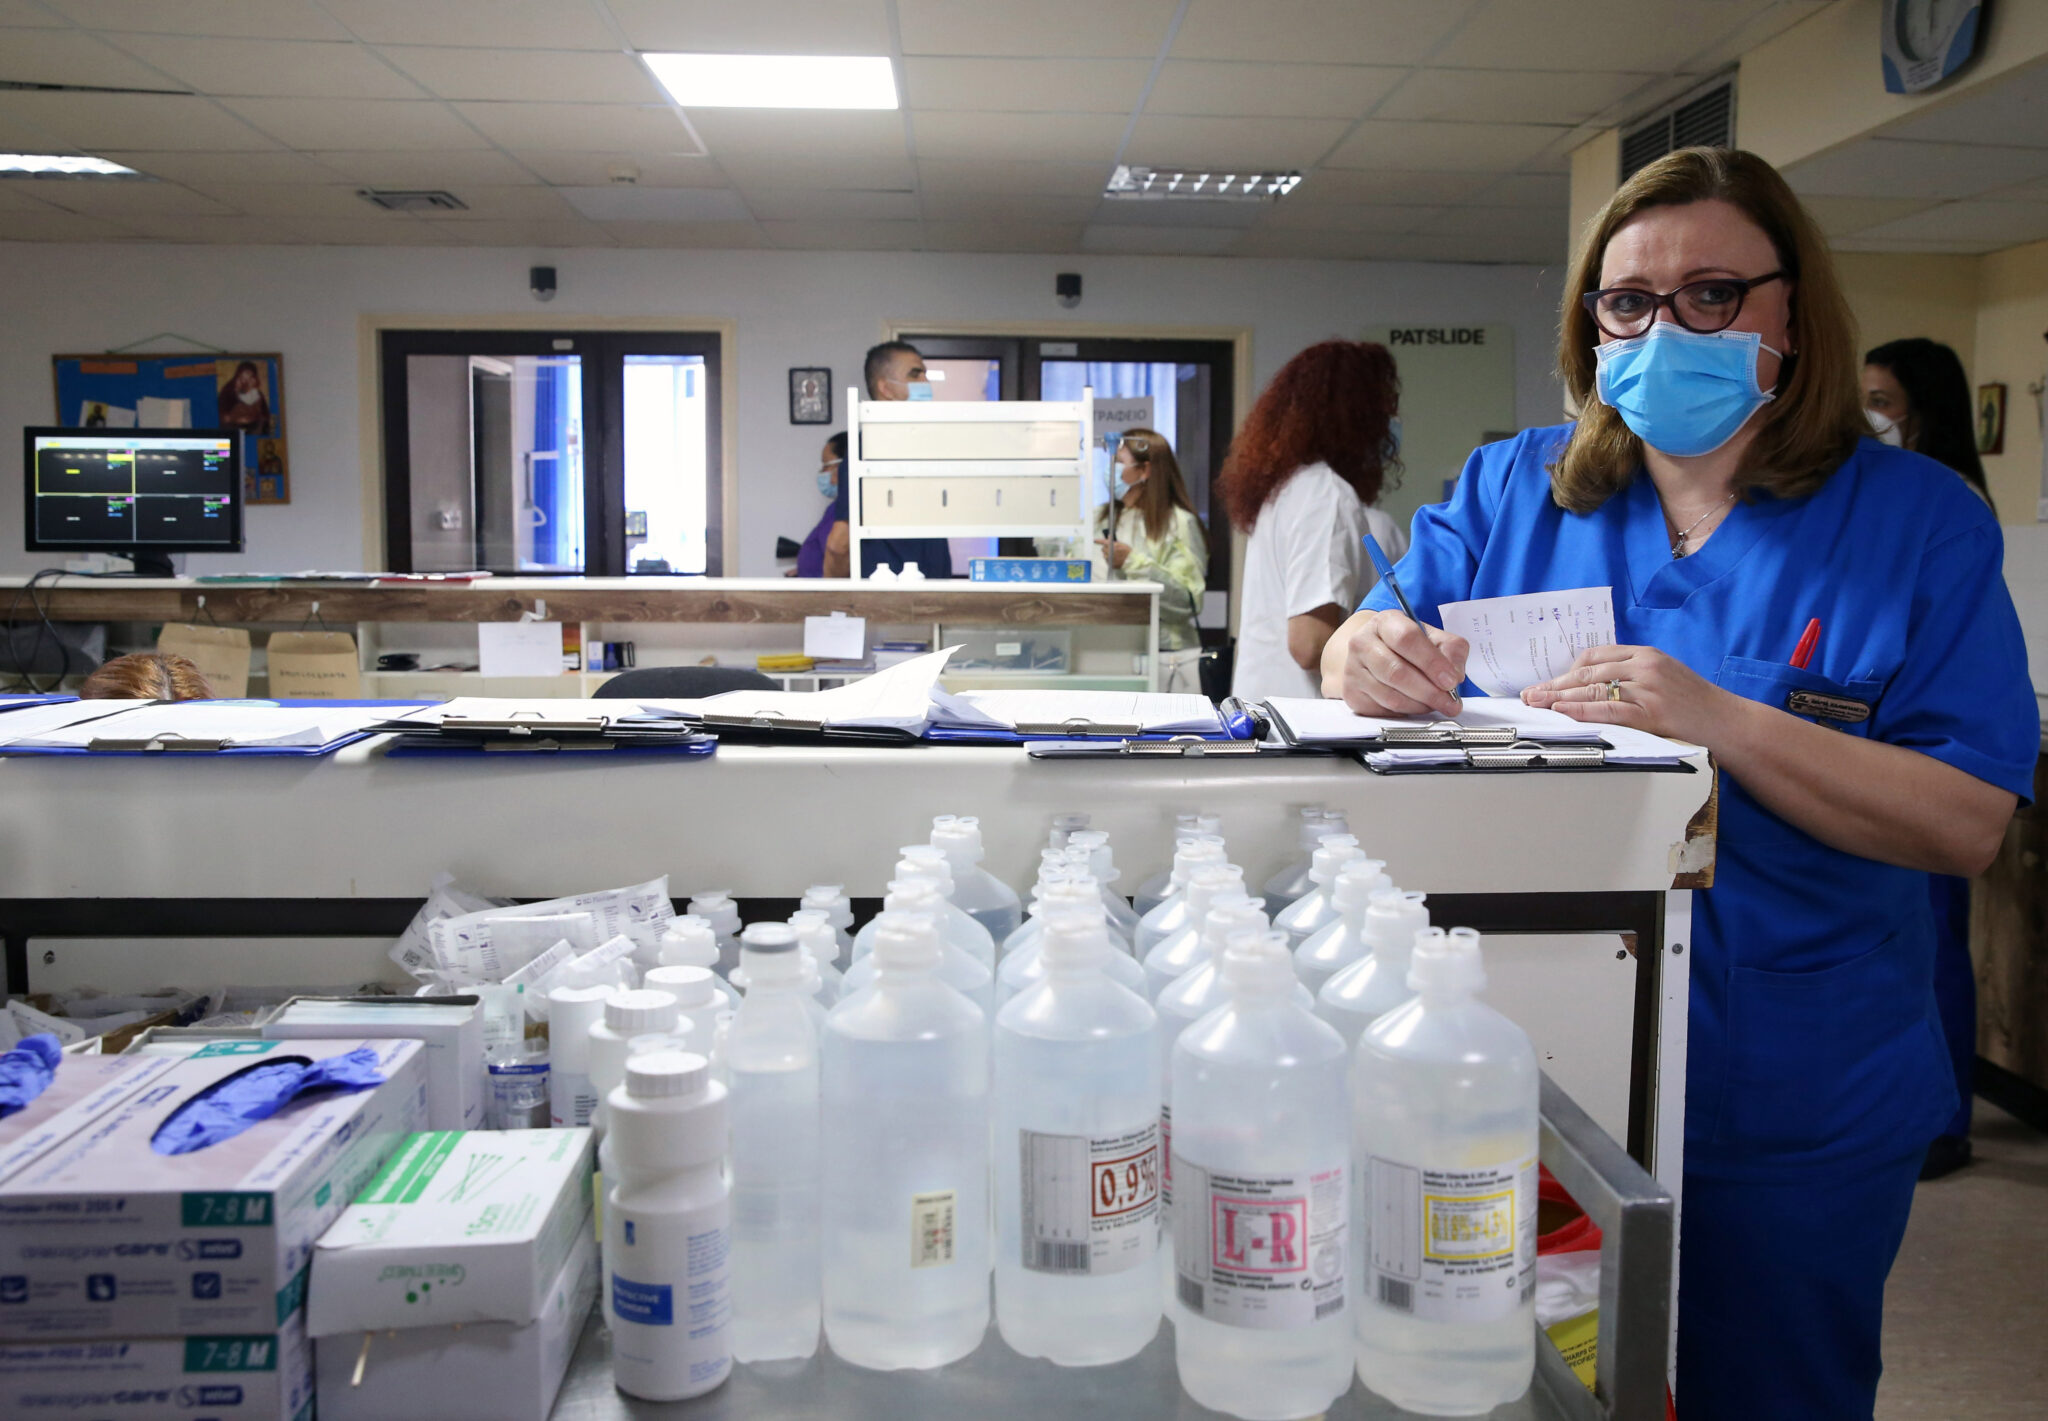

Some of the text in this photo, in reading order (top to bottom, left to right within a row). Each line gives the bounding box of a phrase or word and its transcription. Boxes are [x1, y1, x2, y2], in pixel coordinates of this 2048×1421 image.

[1390, 329, 1485, 345] PATSLIDE
[243, 1197, 267, 1221] M
[1222, 1208, 1298, 1264] L-R
[246, 1341, 270, 1367] M
